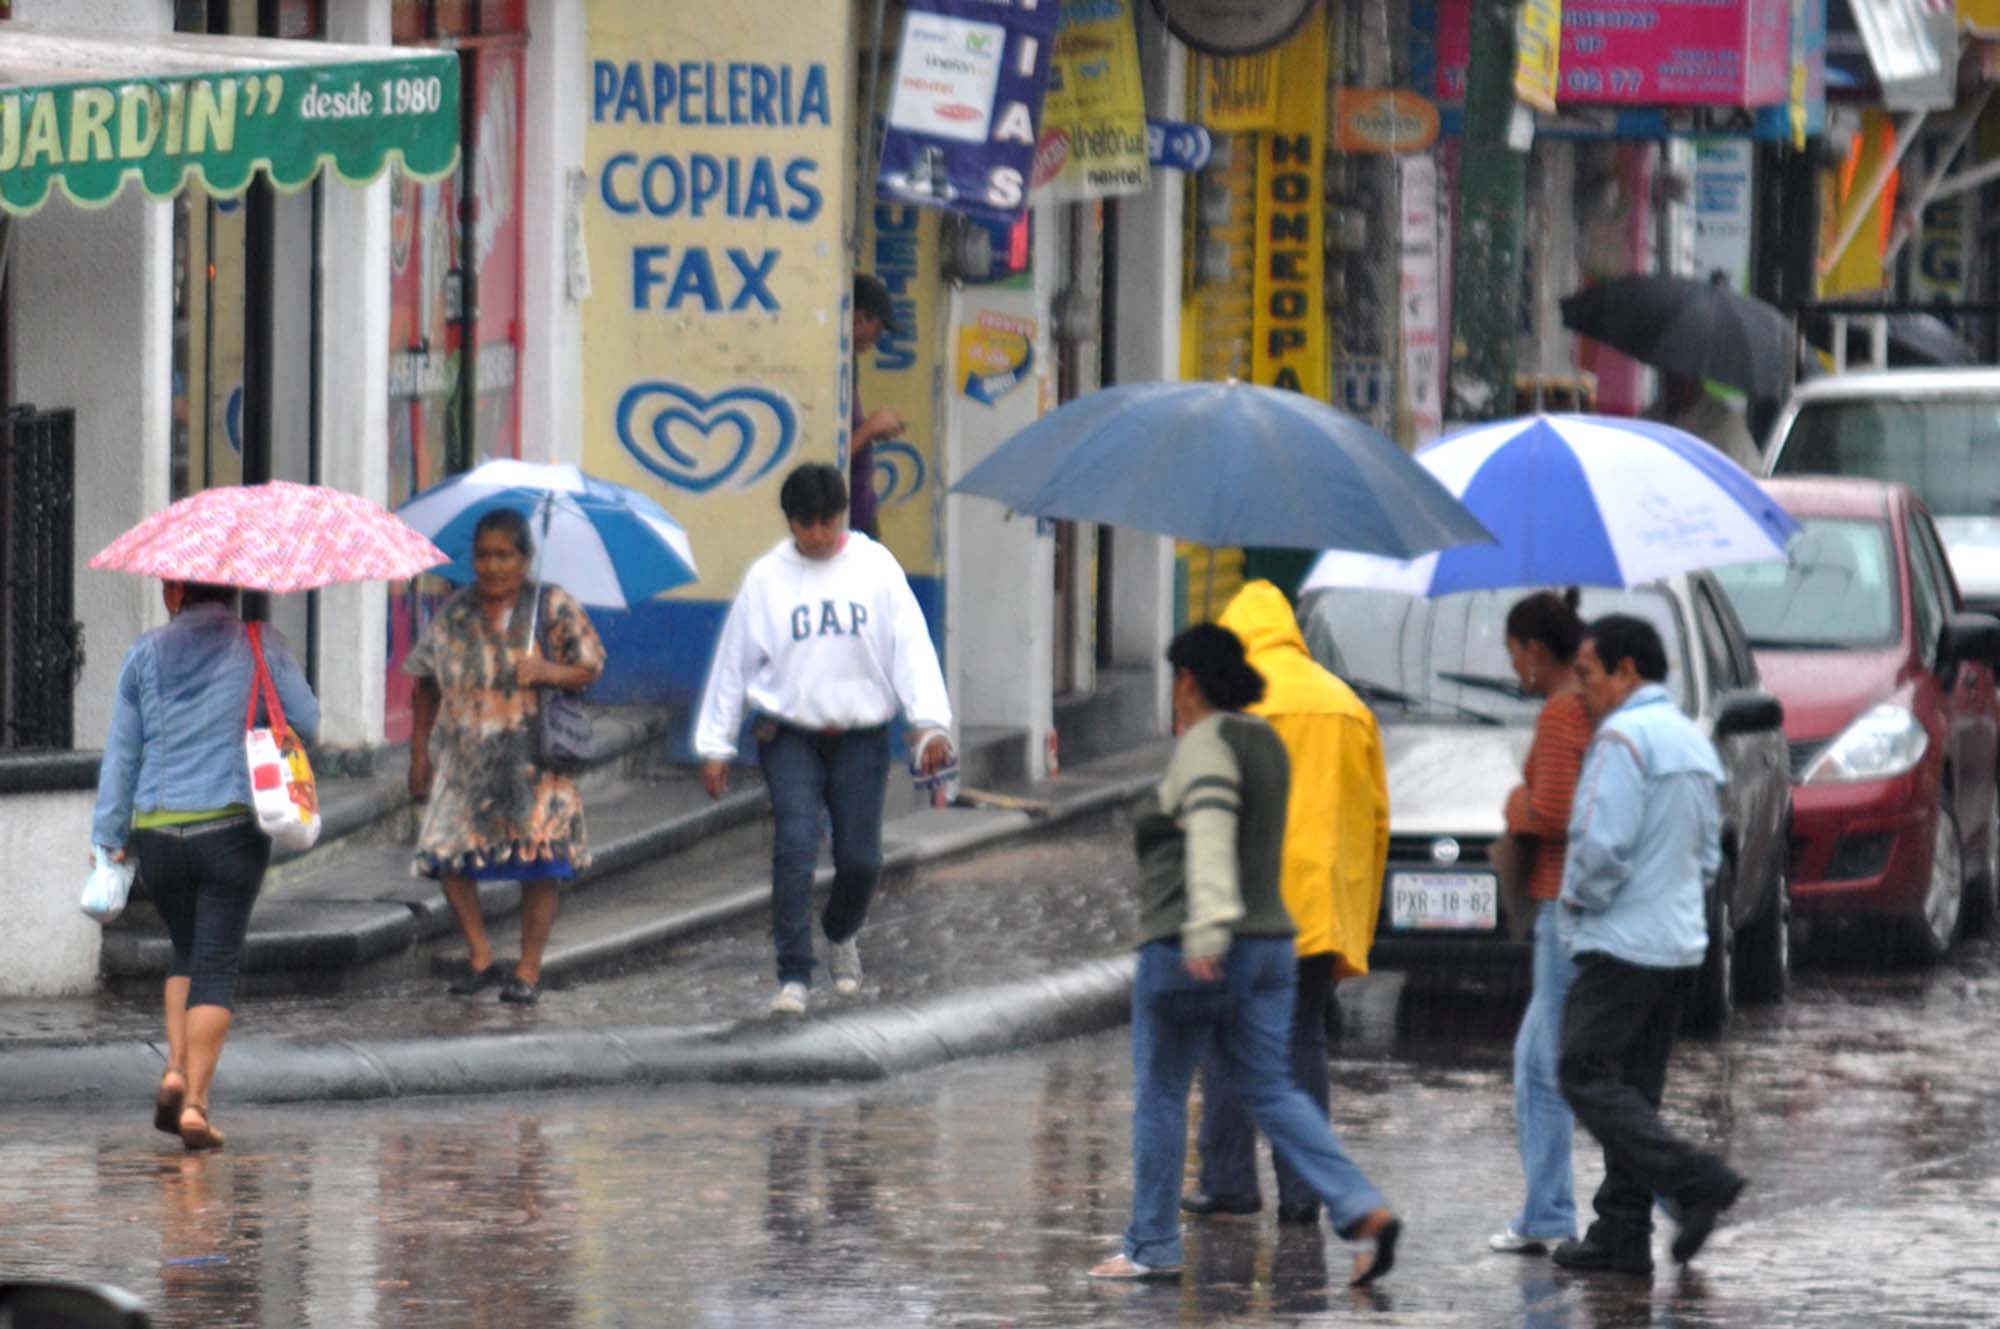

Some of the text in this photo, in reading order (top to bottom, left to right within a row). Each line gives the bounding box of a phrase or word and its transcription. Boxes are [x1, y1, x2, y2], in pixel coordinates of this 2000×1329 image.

[301, 81, 373, 119] desde
[382, 75, 441, 116] 1980
[592, 61, 830, 127] PAPELERIA
[599, 154, 822, 224] COPIAS
[631, 246, 779, 314] FAX
[791, 600, 868, 642] GAP
[1395, 890, 1492, 914] PXR-18-82
